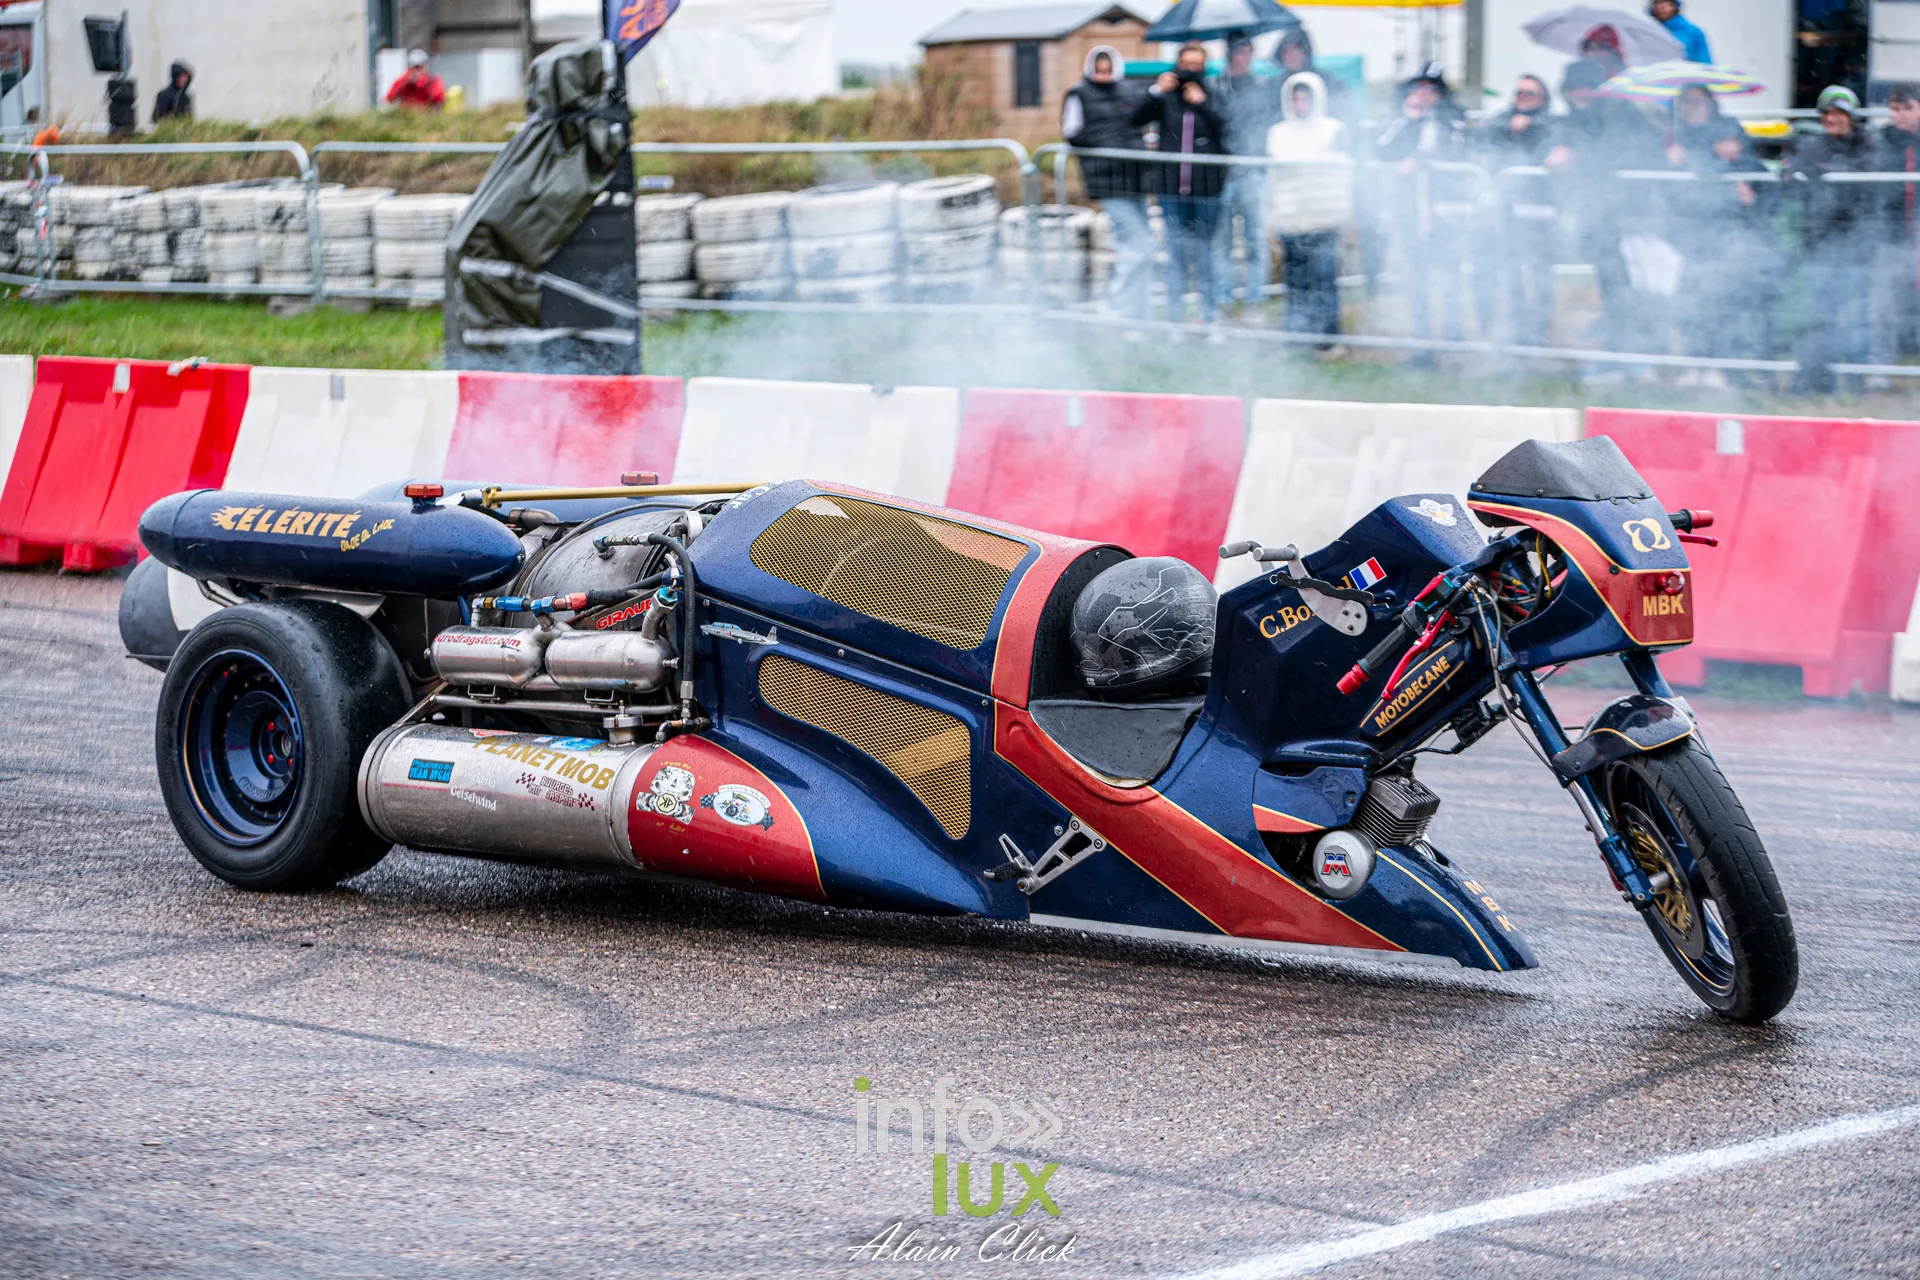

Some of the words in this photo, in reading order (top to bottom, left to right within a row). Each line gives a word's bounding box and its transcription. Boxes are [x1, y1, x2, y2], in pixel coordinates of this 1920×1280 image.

[211, 503, 362, 538] CÉLÉRITÉ
[1643, 594, 1685, 616] MBK
[432, 632, 521, 649] eurodragster.com
[1374, 655, 1452, 730] MOTOBECANE
[472, 736, 615, 790] PLANETMOB
